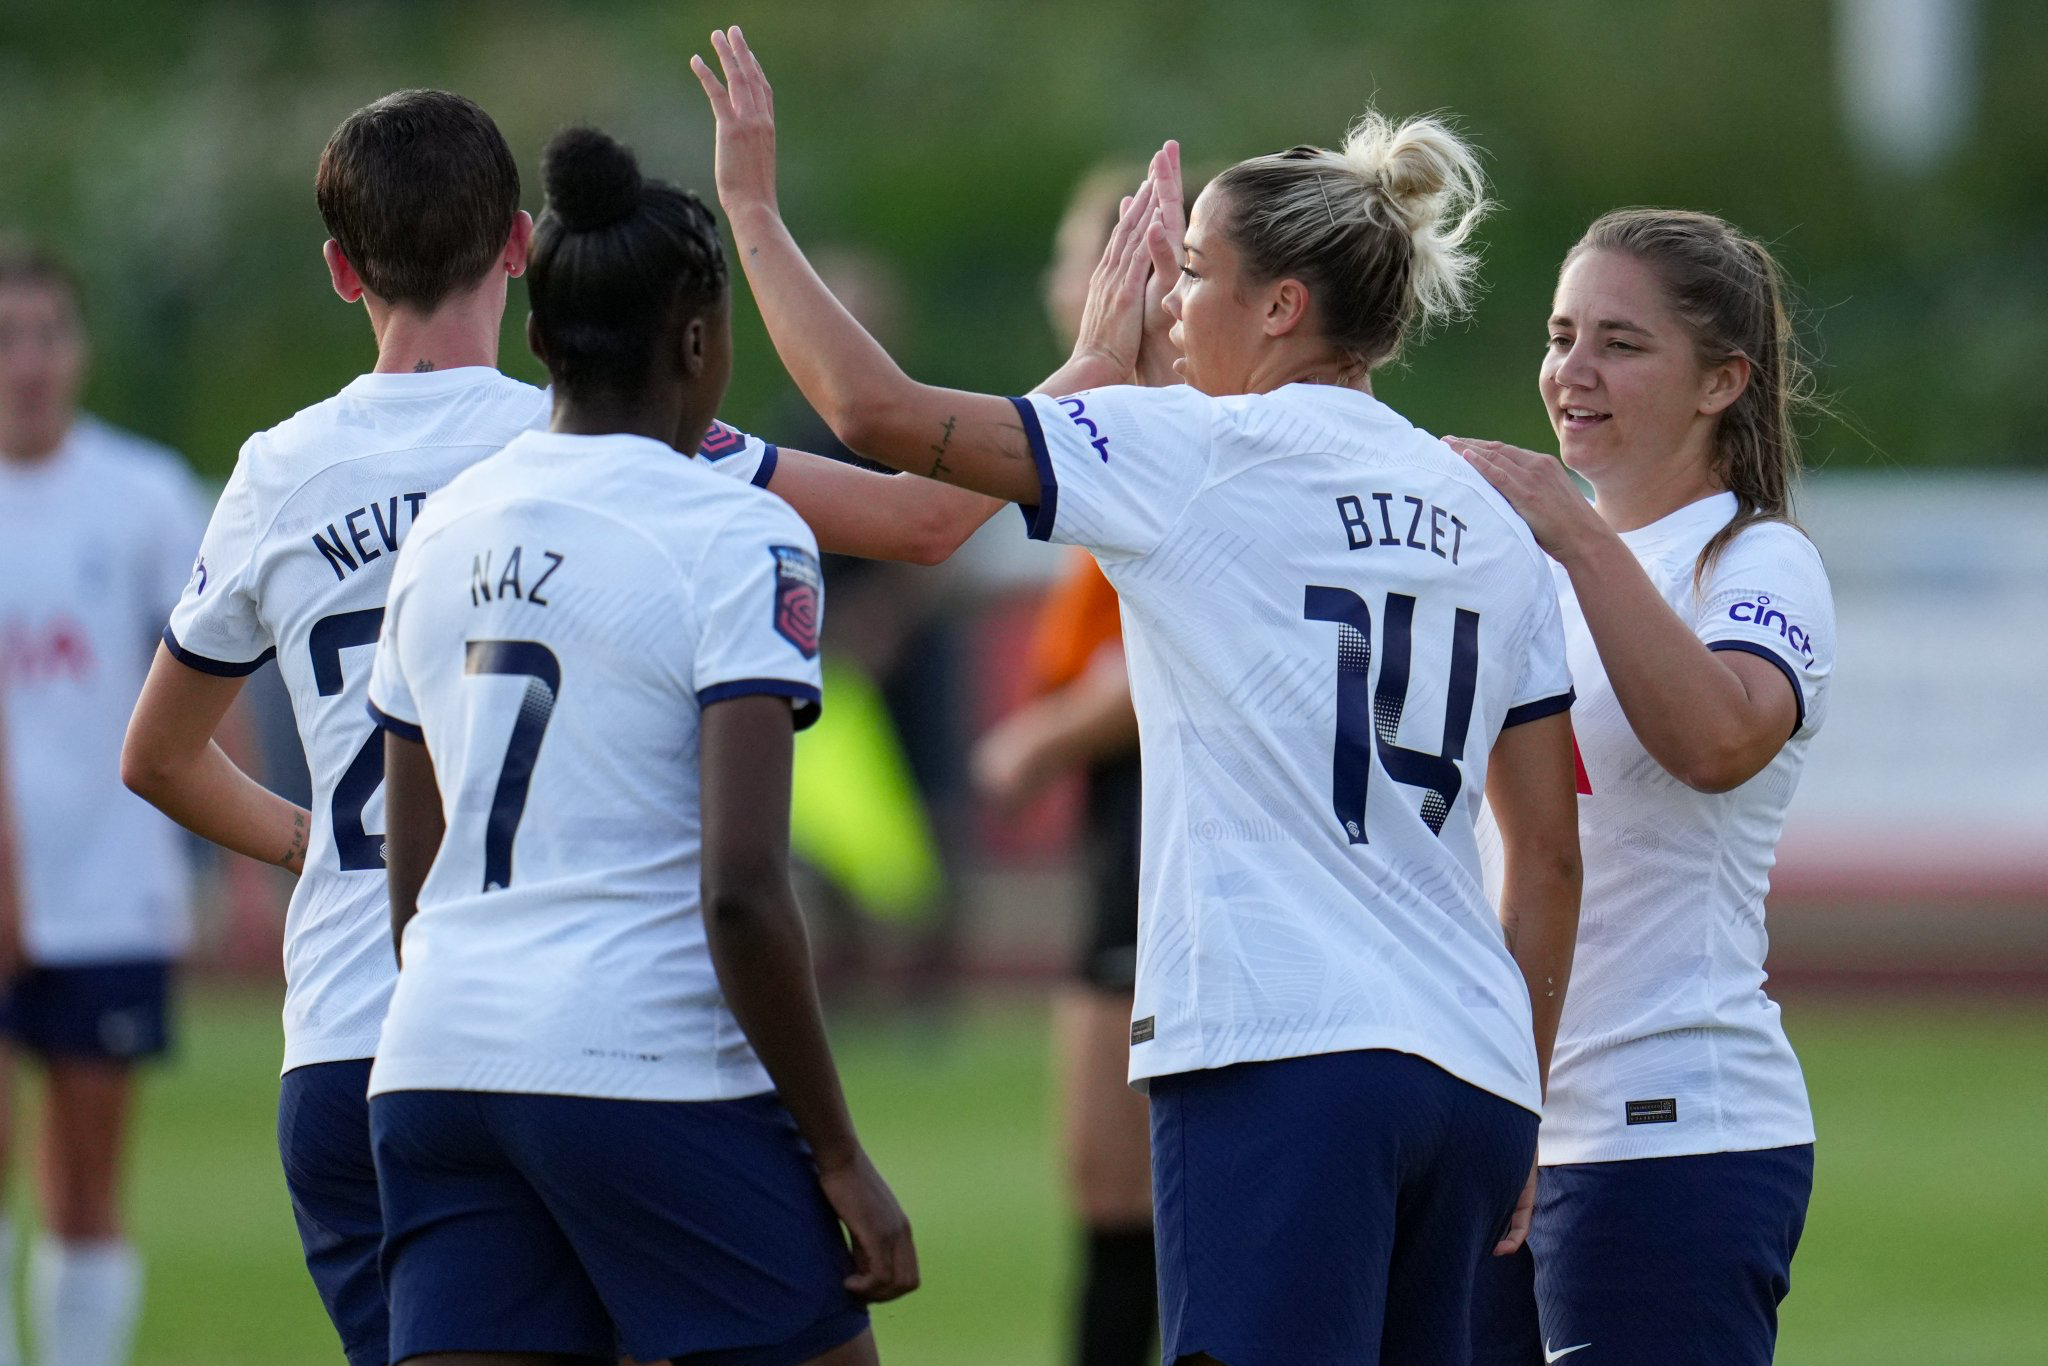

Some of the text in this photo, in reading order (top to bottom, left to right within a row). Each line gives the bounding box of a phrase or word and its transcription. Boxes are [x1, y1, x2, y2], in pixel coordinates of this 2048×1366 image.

[471, 546, 565, 607] NAZ
[1335, 492, 1468, 566] BIZET
[464, 639, 562, 894] 7
[1303, 584, 1481, 845] 14
